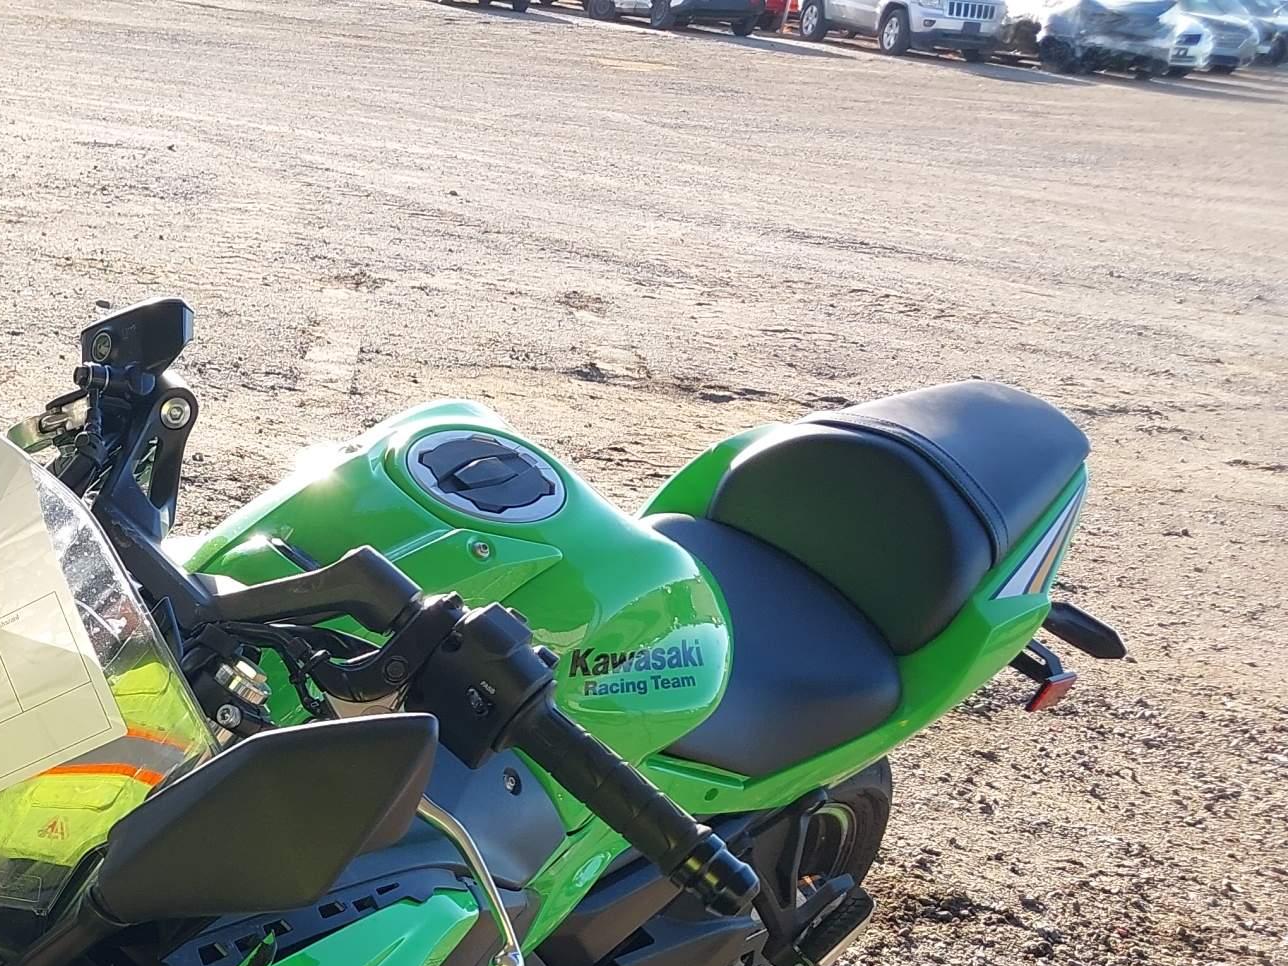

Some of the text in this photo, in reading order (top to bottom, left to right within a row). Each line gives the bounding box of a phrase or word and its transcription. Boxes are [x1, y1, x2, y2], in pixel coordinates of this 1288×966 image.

[569, 639, 704, 677] Kawasaki
[584, 674, 696, 696] Racing Team
